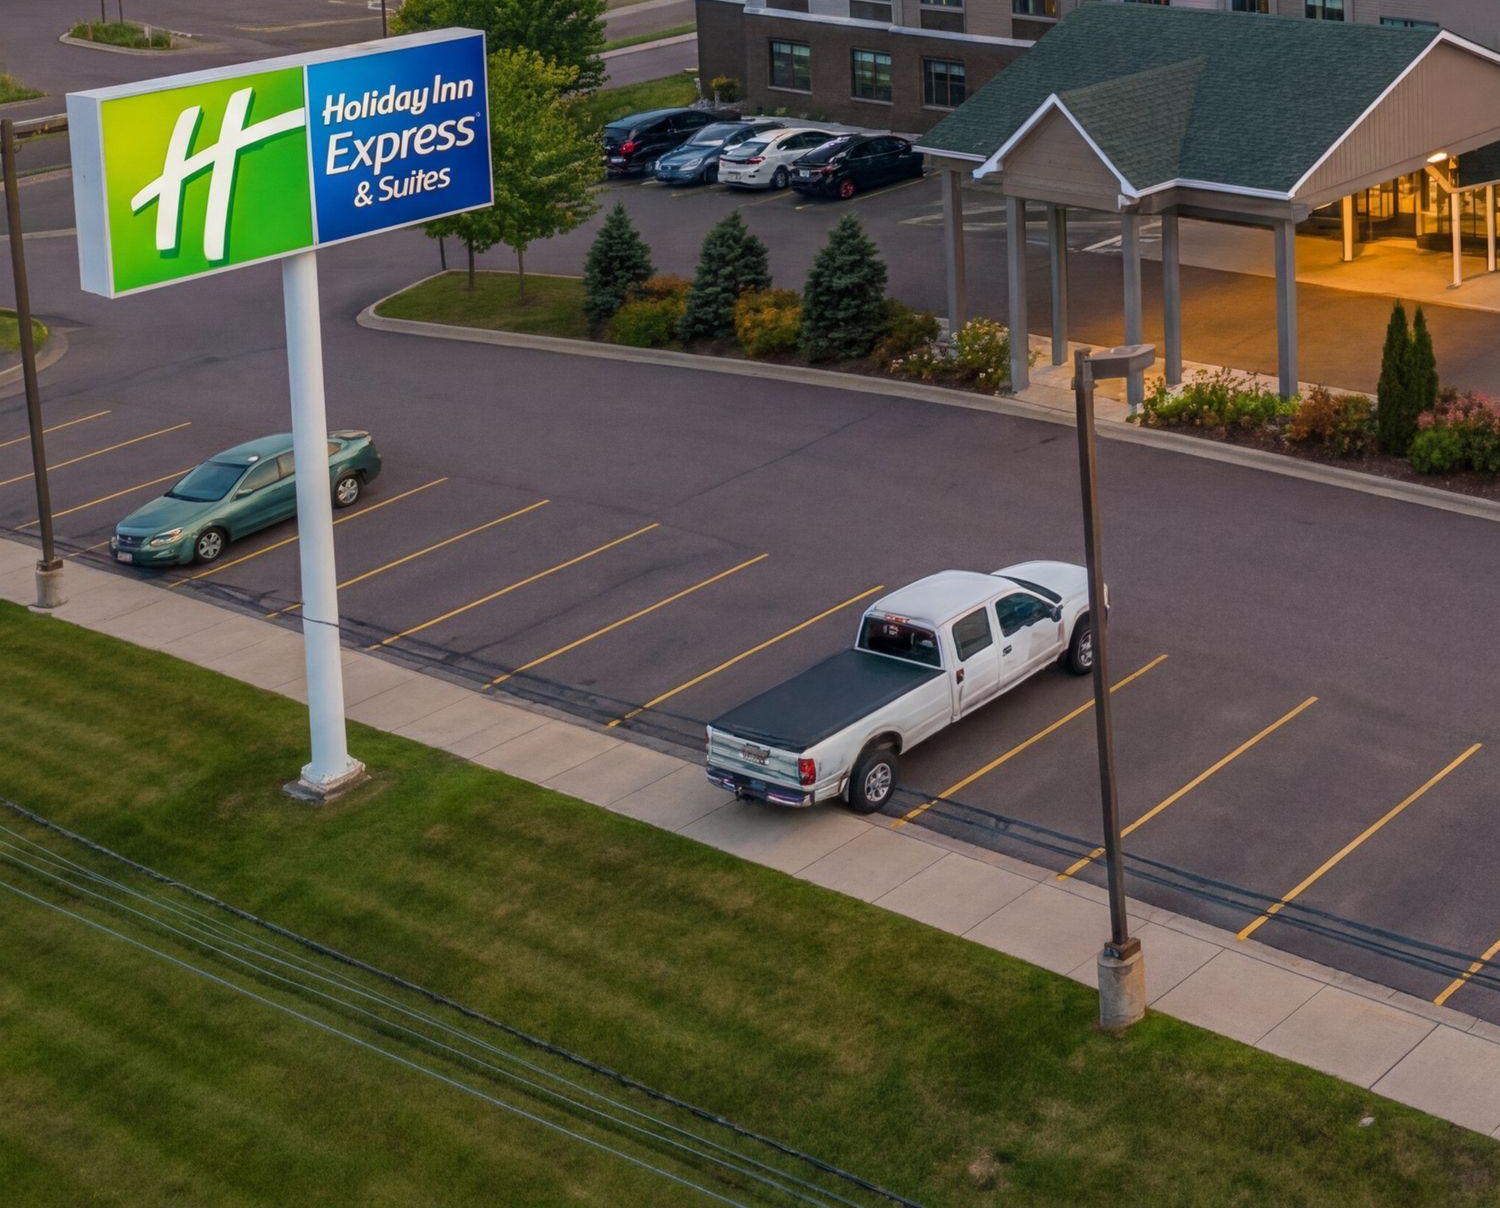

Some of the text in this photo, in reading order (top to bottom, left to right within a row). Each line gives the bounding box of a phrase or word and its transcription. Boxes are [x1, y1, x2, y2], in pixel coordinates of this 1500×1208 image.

[322, 74, 474, 125] Holiday Inn
[326, 115, 476, 176] Express
[354, 167, 451, 208] & Suites
